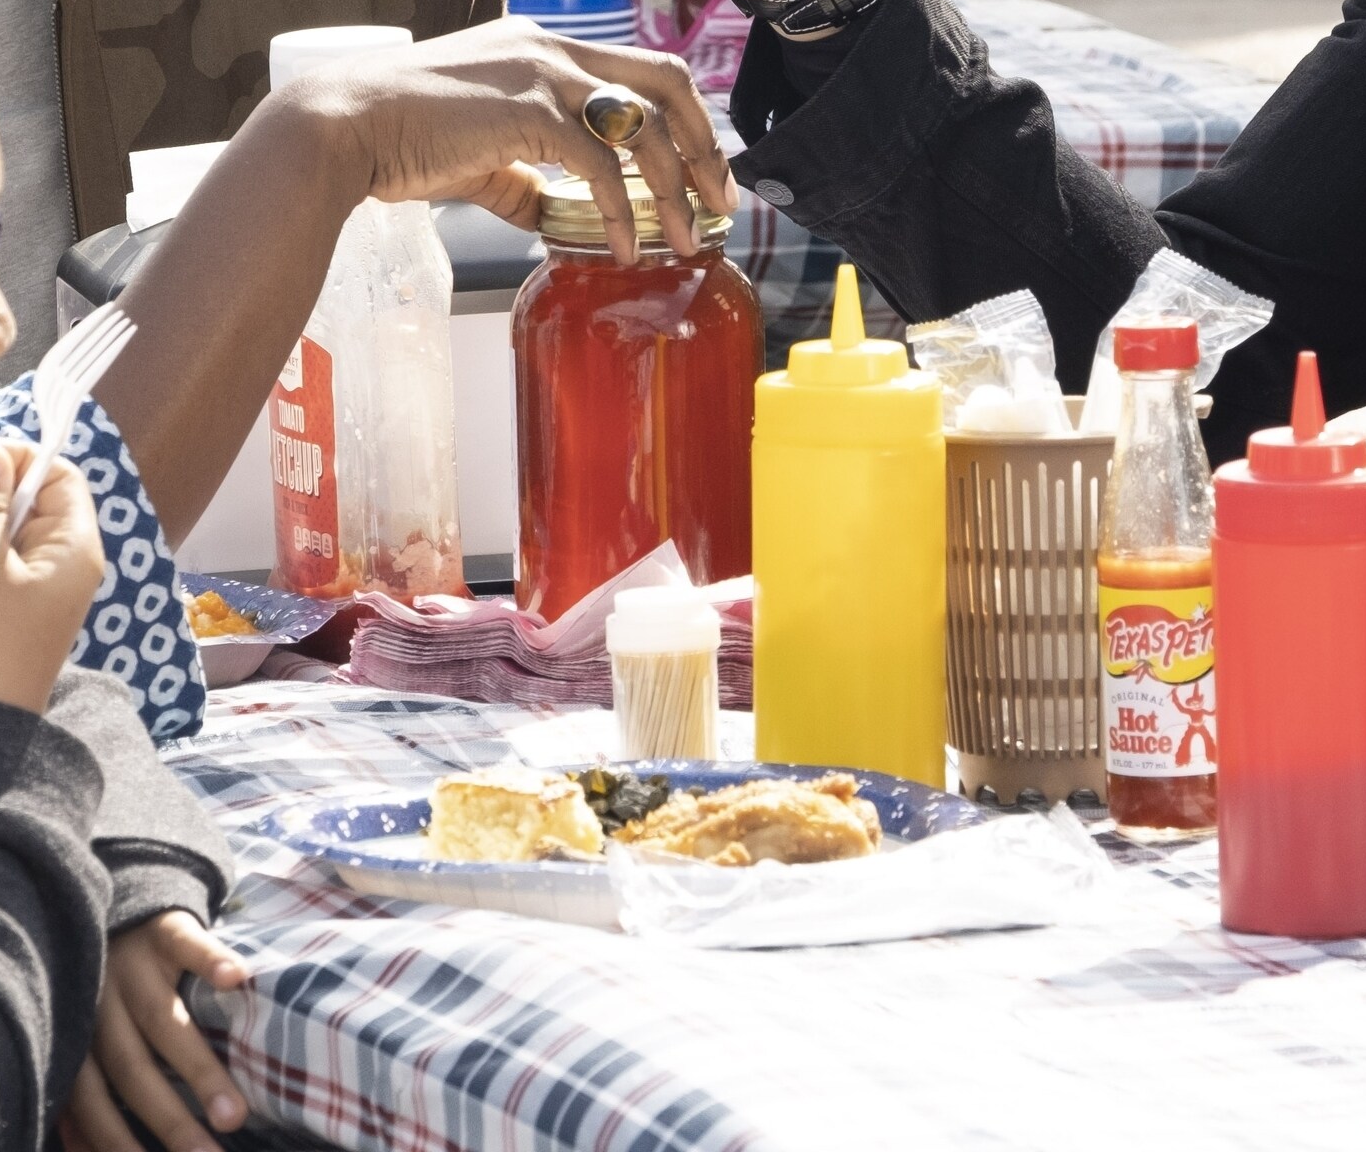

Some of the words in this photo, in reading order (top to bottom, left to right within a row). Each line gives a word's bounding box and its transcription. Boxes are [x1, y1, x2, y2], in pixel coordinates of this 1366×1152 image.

[278, 399, 305, 434] TOMATO
[1105, 617, 1166, 663] TEXAS
[1163, 618, 1214, 668] PET
[1111, 691, 1165, 708] ORIGINAL
[1118, 706, 1159, 733] Hot
[1109, 726, 1173, 754] Sauce
